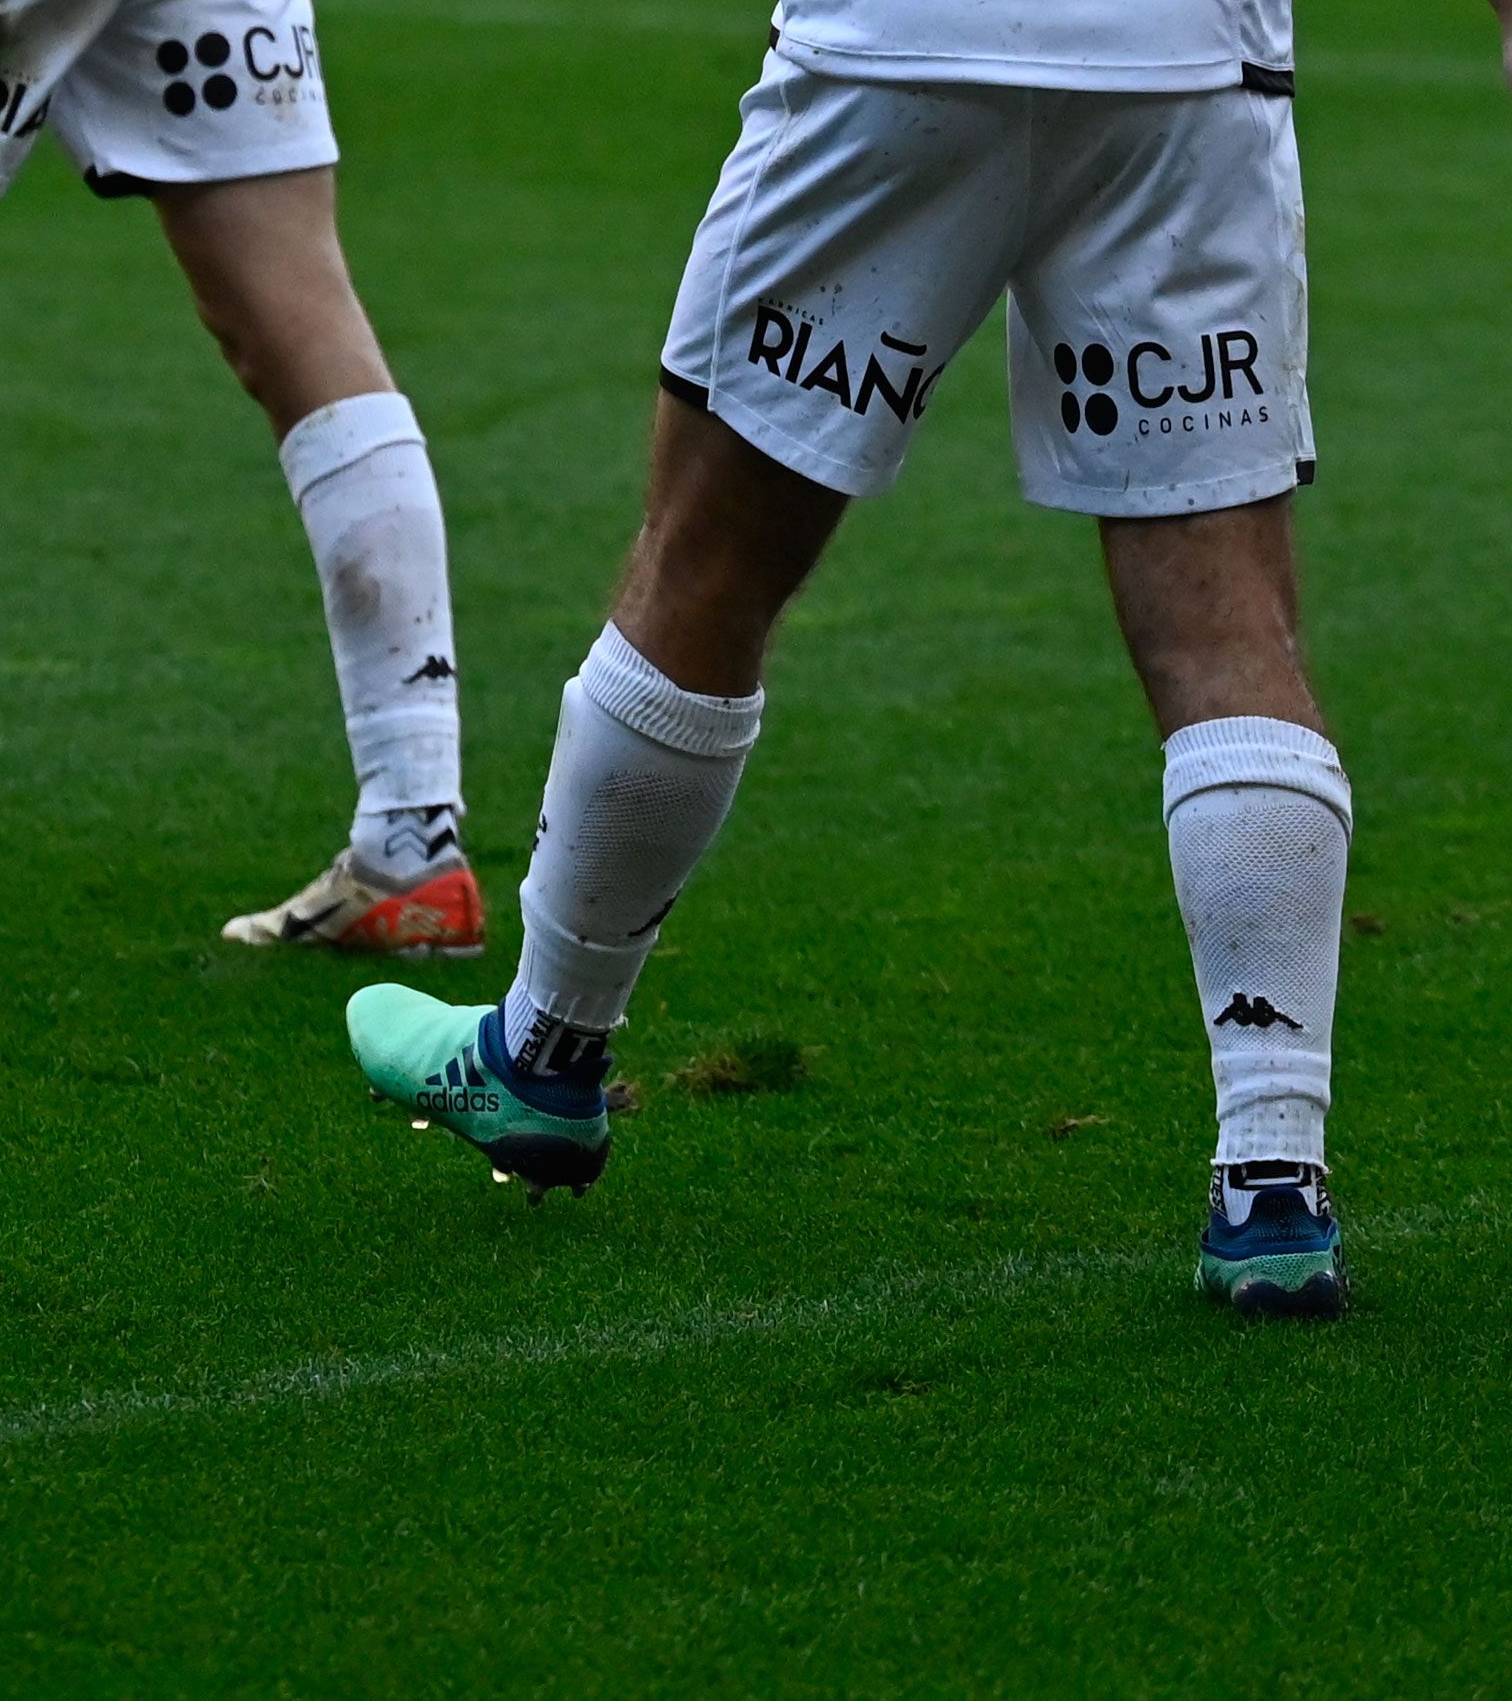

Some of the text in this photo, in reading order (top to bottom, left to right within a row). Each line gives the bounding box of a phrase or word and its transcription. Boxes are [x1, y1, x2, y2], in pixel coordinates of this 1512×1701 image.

[1127, 330, 1264, 409] CJR
[1138, 405, 1270, 435] COCINAS
[416, 1086, 500, 1113] adidas
